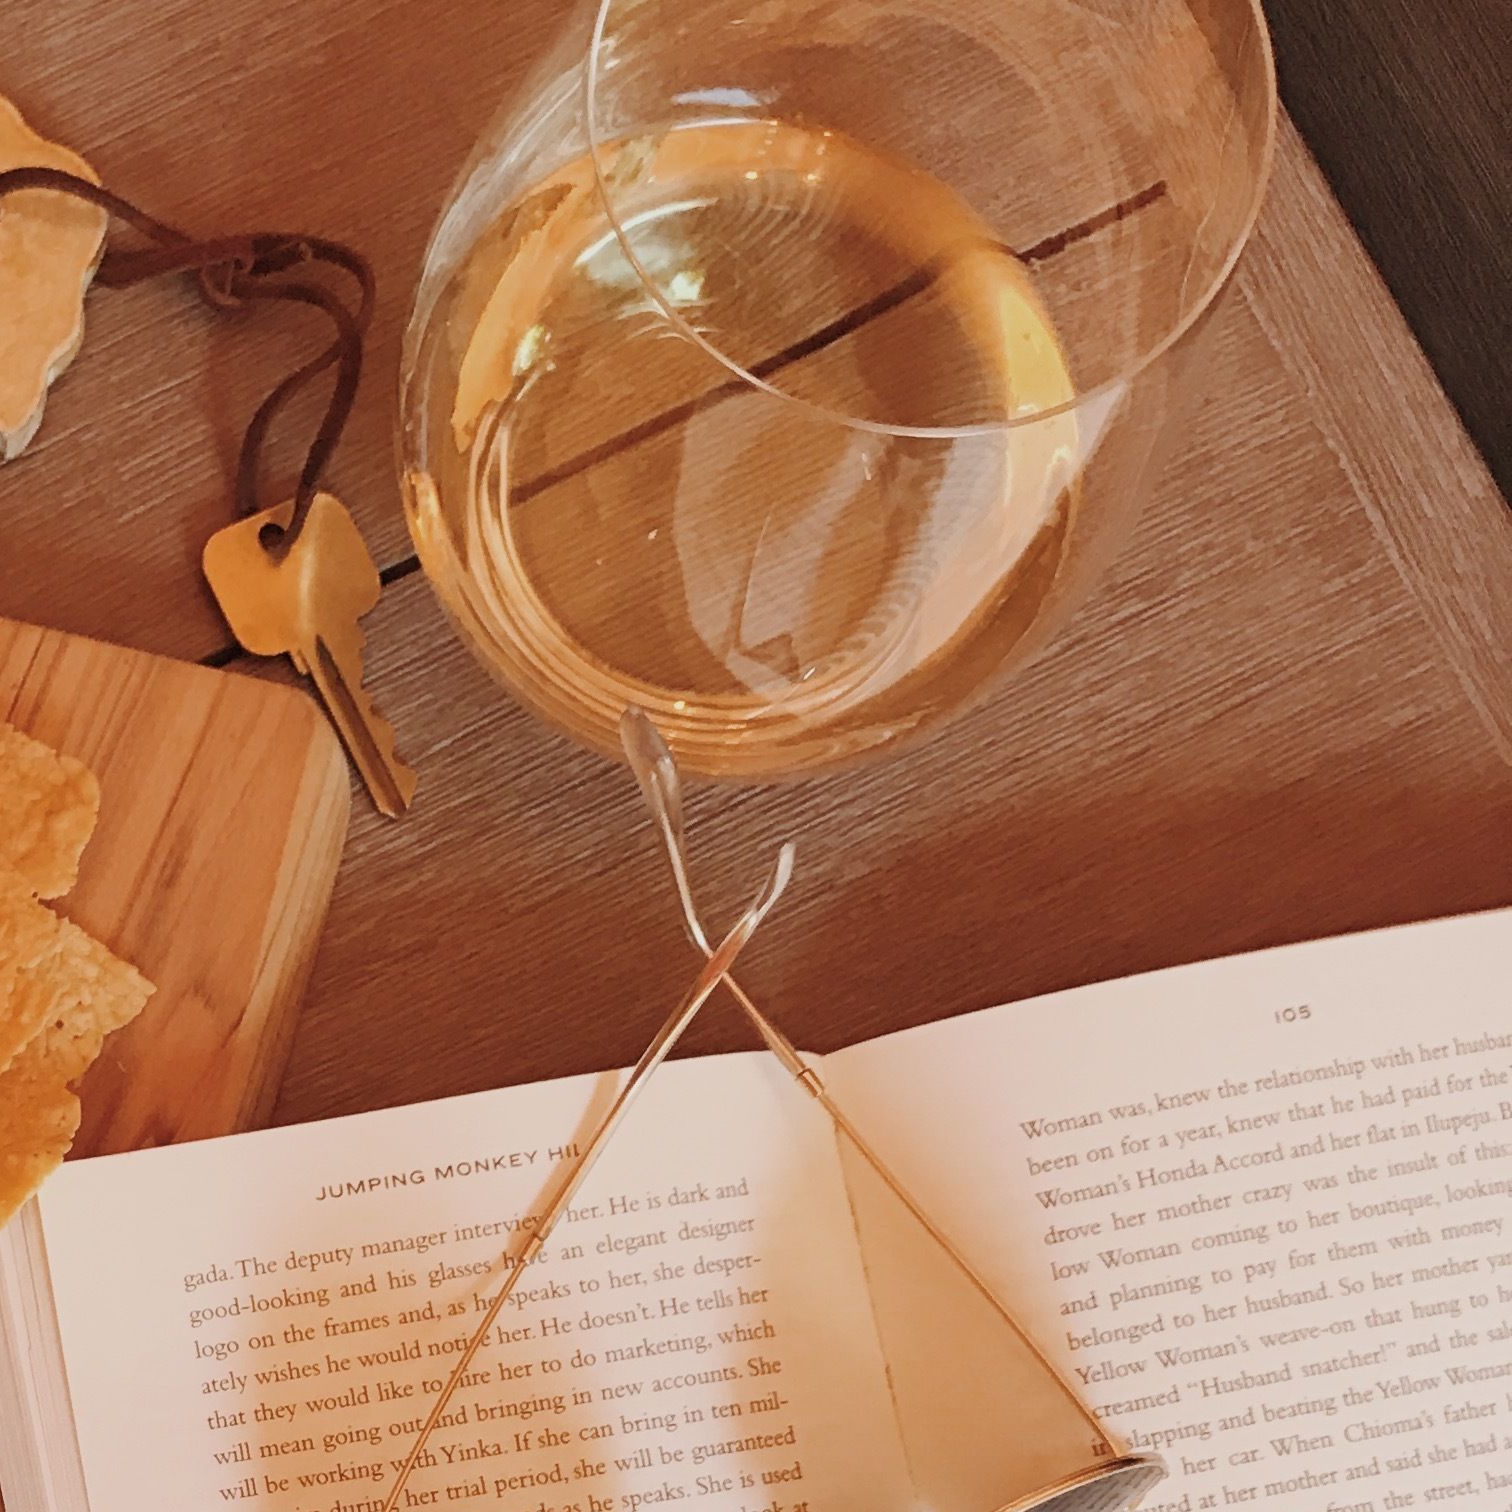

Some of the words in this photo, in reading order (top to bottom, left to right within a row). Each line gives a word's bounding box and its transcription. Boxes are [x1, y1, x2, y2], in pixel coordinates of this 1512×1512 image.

[1274, 1004, 1312, 1024] 105
[1019, 1112, 1103, 1139] Woman
[1154, 1089, 1211, 1112] knew
[1217, 1079, 1249, 1099] the
[1254, 1058, 1366, 1092] relationship
[1370, 1047, 1414, 1069] with
[1417, 1044, 1449, 1062] her
[315, 1169, 426, 1202] JUMPING
[434, 1150, 538, 1181] MONKEY
[547, 1143, 581, 1161] HIL
[1044, 1222, 1102, 1246] drove
[1110, 1212, 1146, 1231] her
[1157, 1194, 1232, 1221] mother
[1242, 1183, 1292, 1204] crazy
[1302, 1175, 1339, 1191] was
[1347, 1165, 1378, 1184] the
[1387, 1152, 1438, 1177] insult
[1447, 1145, 1466, 1166] of
[189, 1286, 331, 1329] good-looking
[339, 1272, 379, 1299] and
[386, 1268, 417, 1291] his
[427, 1260, 499, 1289] glasses
[560, 1244, 585, 1261] an
[595, 1230, 668, 1256] elegant
[677, 1218, 755, 1242] designer
[1060, 1290, 1099, 1316] and
[1109, 1275, 1203, 1311] planning
[1211, 1269, 1232, 1284] to
[1243, 1260, 1276, 1284] pay
[1288, 1249, 1316, 1269] for
[1327, 1241, 1378, 1261] them
[1387, 1227, 1431, 1249] with
[1441, 1218, 1502, 1240] money
[1074, 1360, 1148, 1386] Yellow
[1259, 1320, 1356, 1348] weave-on
[1364, 1308, 1402, 1328] that
[1410, 1299, 1462, 1319] hung
[1469, 1294, 1488, 1308] to
[212, 1440, 254, 1465] will
[258, 1437, 319, 1459] mean
[322, 1424, 383, 1454] going
[389, 1418, 424, 1437] out
[472, 1393, 567, 1423] bringing
[571, 1386, 593, 1407] in
[600, 1381, 644, 1401] new
[651, 1366, 744, 1393] accounts.
[746, 1355, 783, 1378] She
[403, 1487, 440, 1509] her
[445, 1475, 489, 1501] trial
[493, 1462, 570, 1499] period,
[572, 1458, 608, 1480] she
[613, 1447, 654, 1472] will
[657, 1445, 685, 1465] be
[691, 1424, 797, 1466] guaranteed
[1383, 1491, 1414, 1510] the
